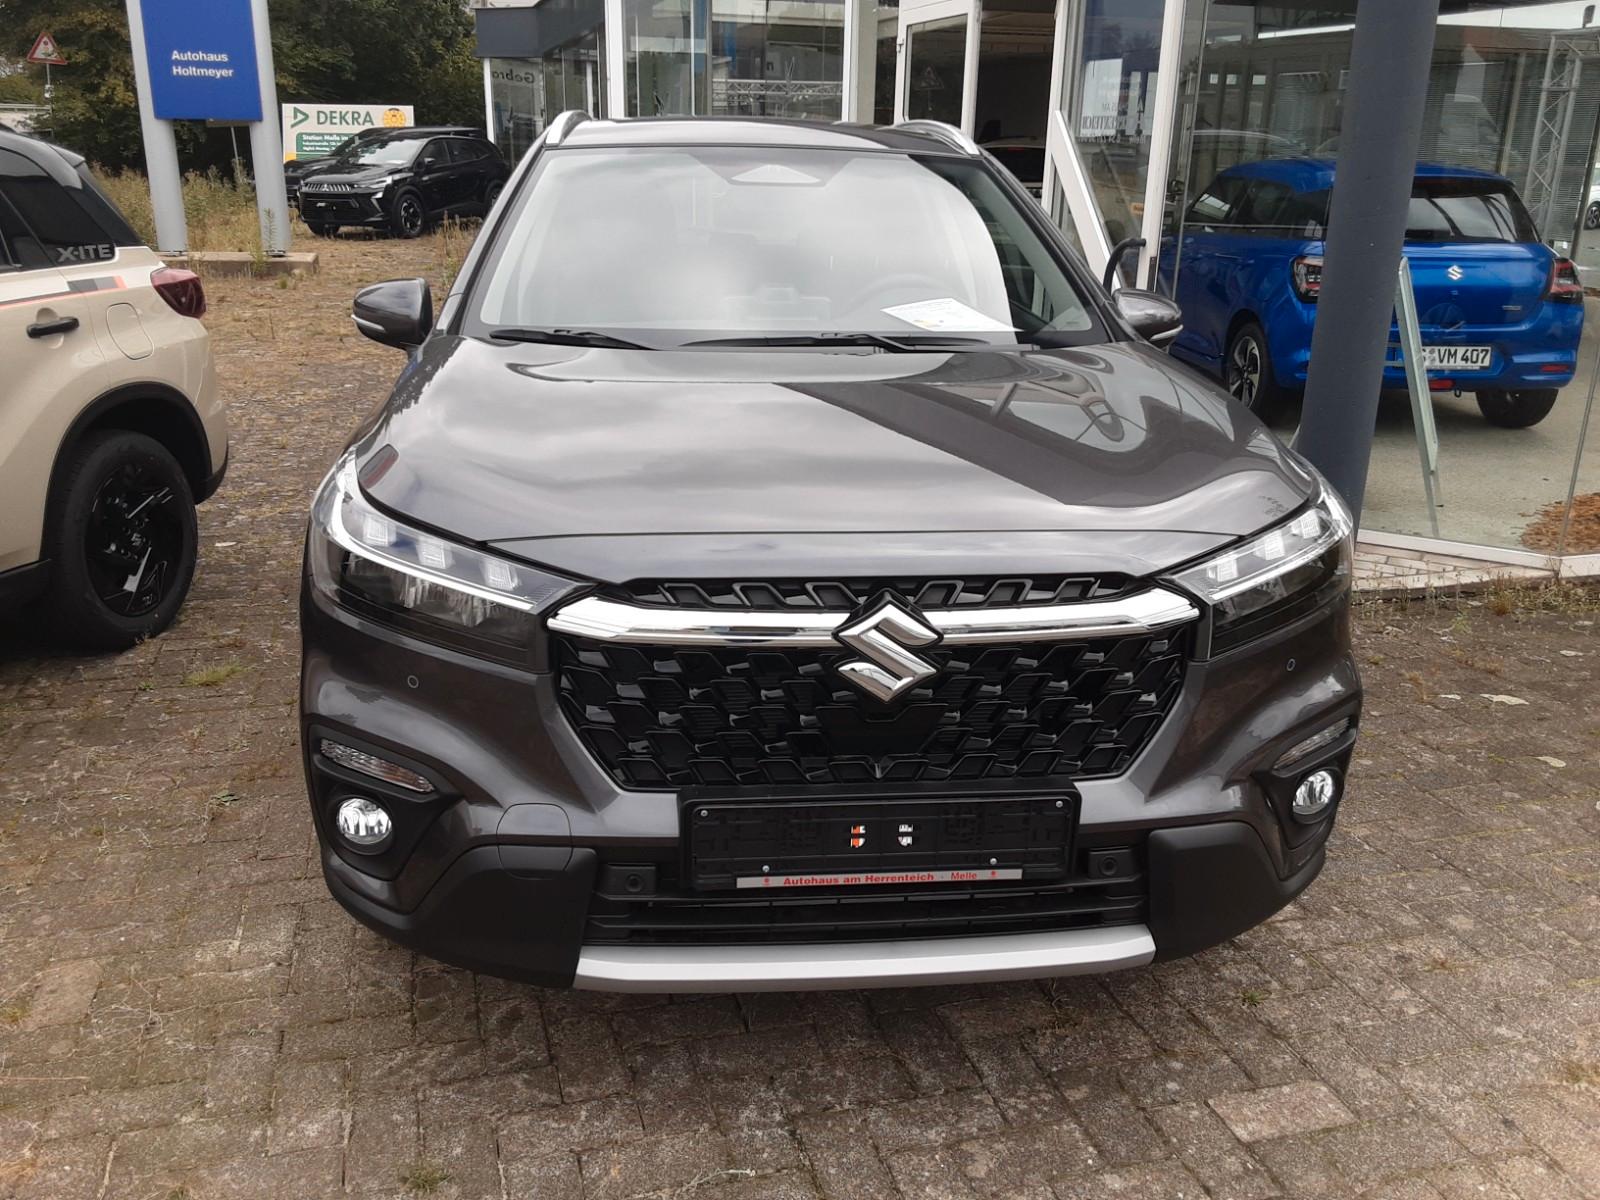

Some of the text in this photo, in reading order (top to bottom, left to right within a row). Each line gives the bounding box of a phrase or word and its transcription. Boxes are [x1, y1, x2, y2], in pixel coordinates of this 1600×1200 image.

[172, 50, 229, 62] Autohaus
[172, 65, 234, 79] Holtmeyer
[316, 110, 375, 126] DEKRA
[56, 243, 113, 262] X-ITE
[1437, 348, 1458, 364] VM
[1461, 348, 1490, 364] 407
[783, 871, 978, 886] Autohaus am Herrenteich Melle
